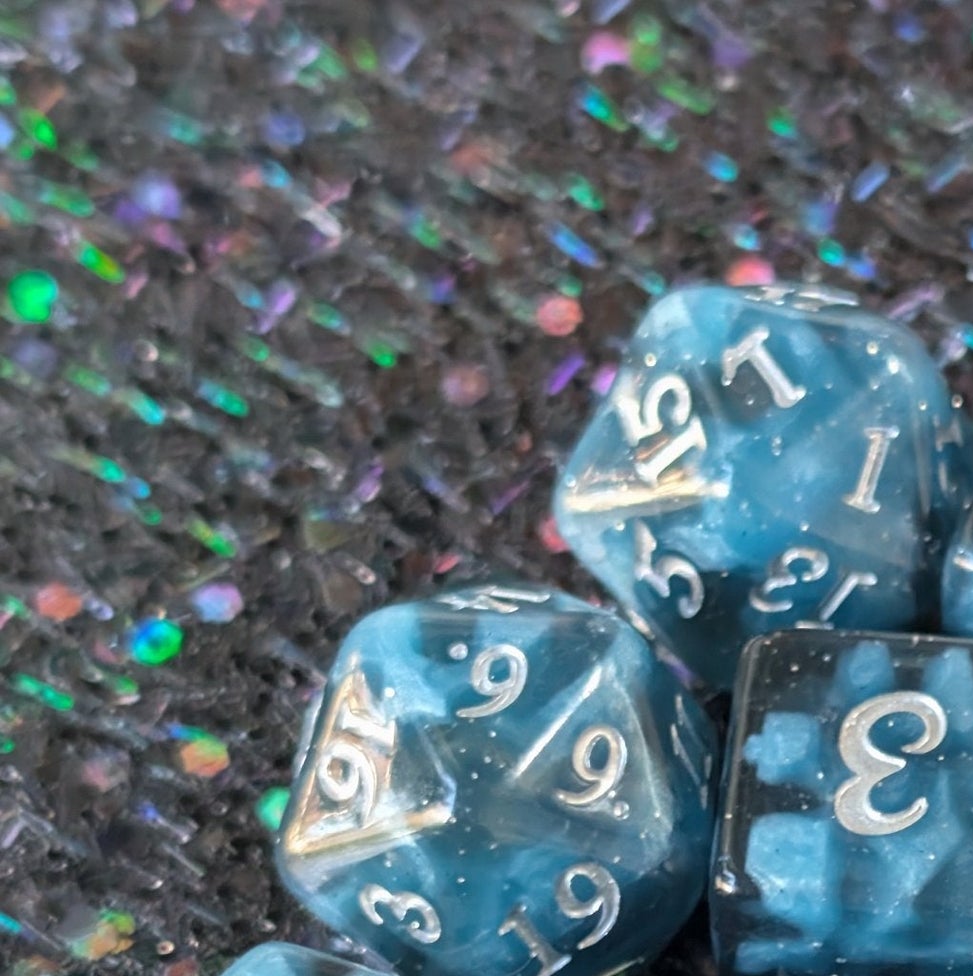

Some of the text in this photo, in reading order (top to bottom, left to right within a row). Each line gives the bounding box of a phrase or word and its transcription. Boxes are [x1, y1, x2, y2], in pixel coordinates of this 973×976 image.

[841, 425, 899, 513] 1
[634, 518, 704, 619] 5
[834, 691, 948, 837] 3
[359, 884, 441, 944] 3
